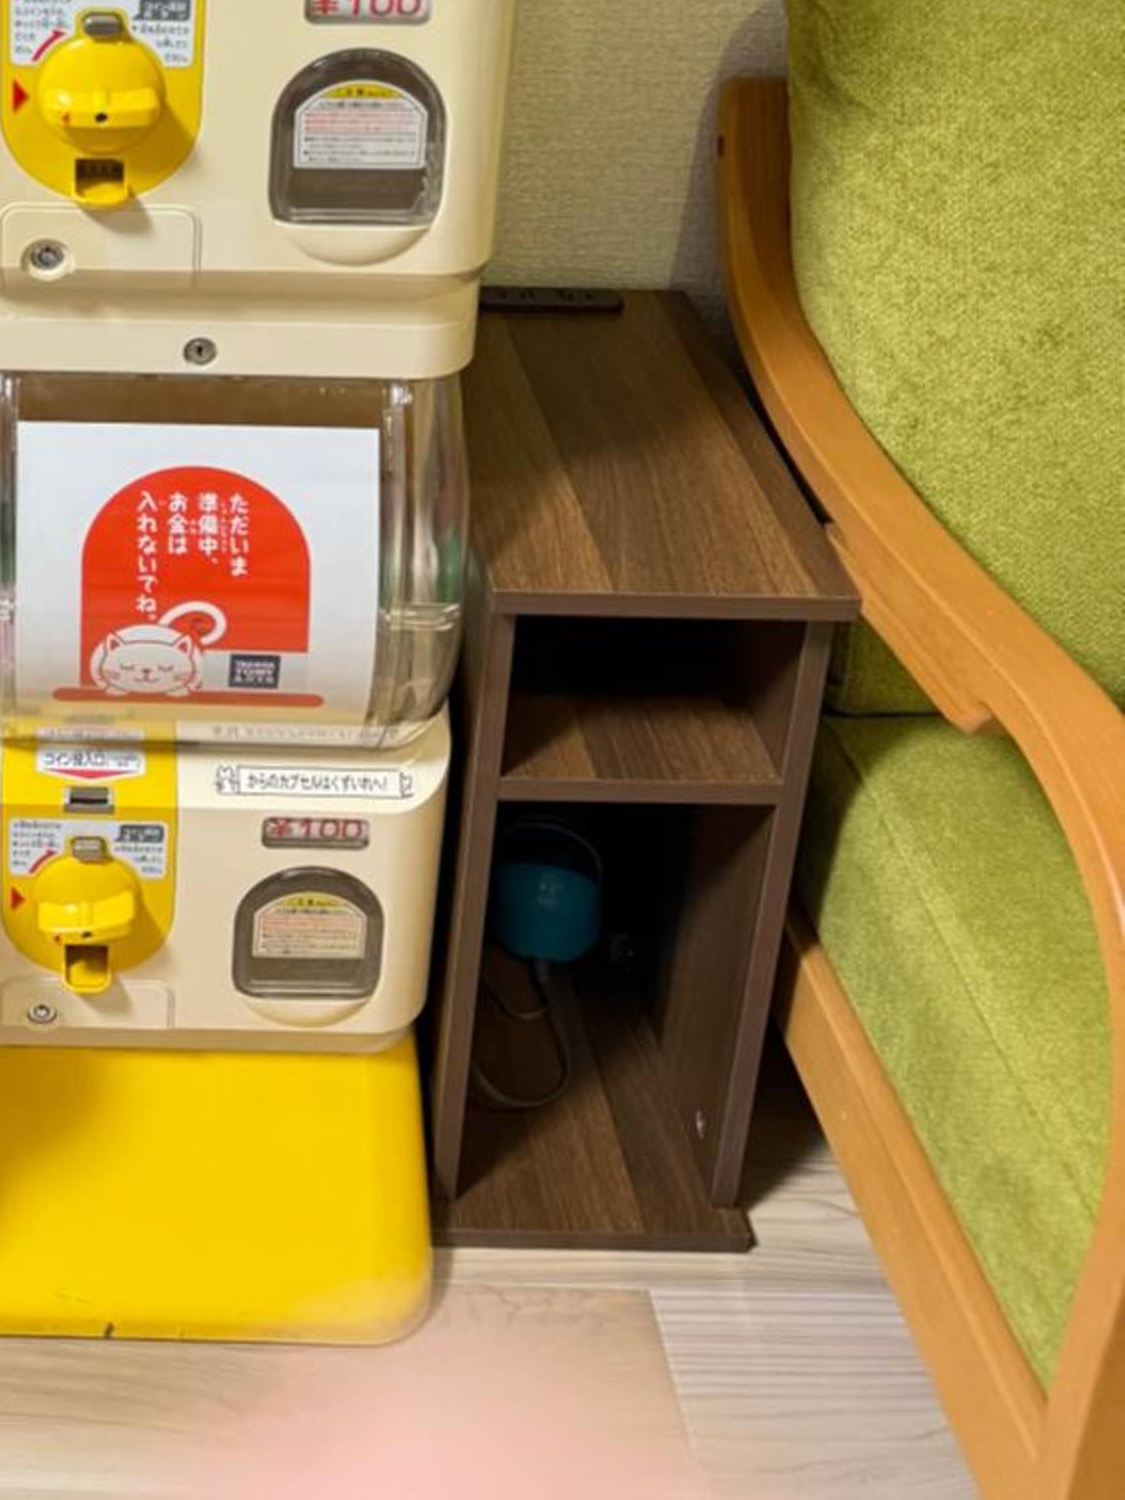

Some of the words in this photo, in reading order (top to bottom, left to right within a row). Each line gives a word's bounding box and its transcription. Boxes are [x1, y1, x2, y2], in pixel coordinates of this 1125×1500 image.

[167, 492, 188, 555] お金は
[198, 492, 219, 565] 準備中、
[229, 492, 249, 577] ただいま
